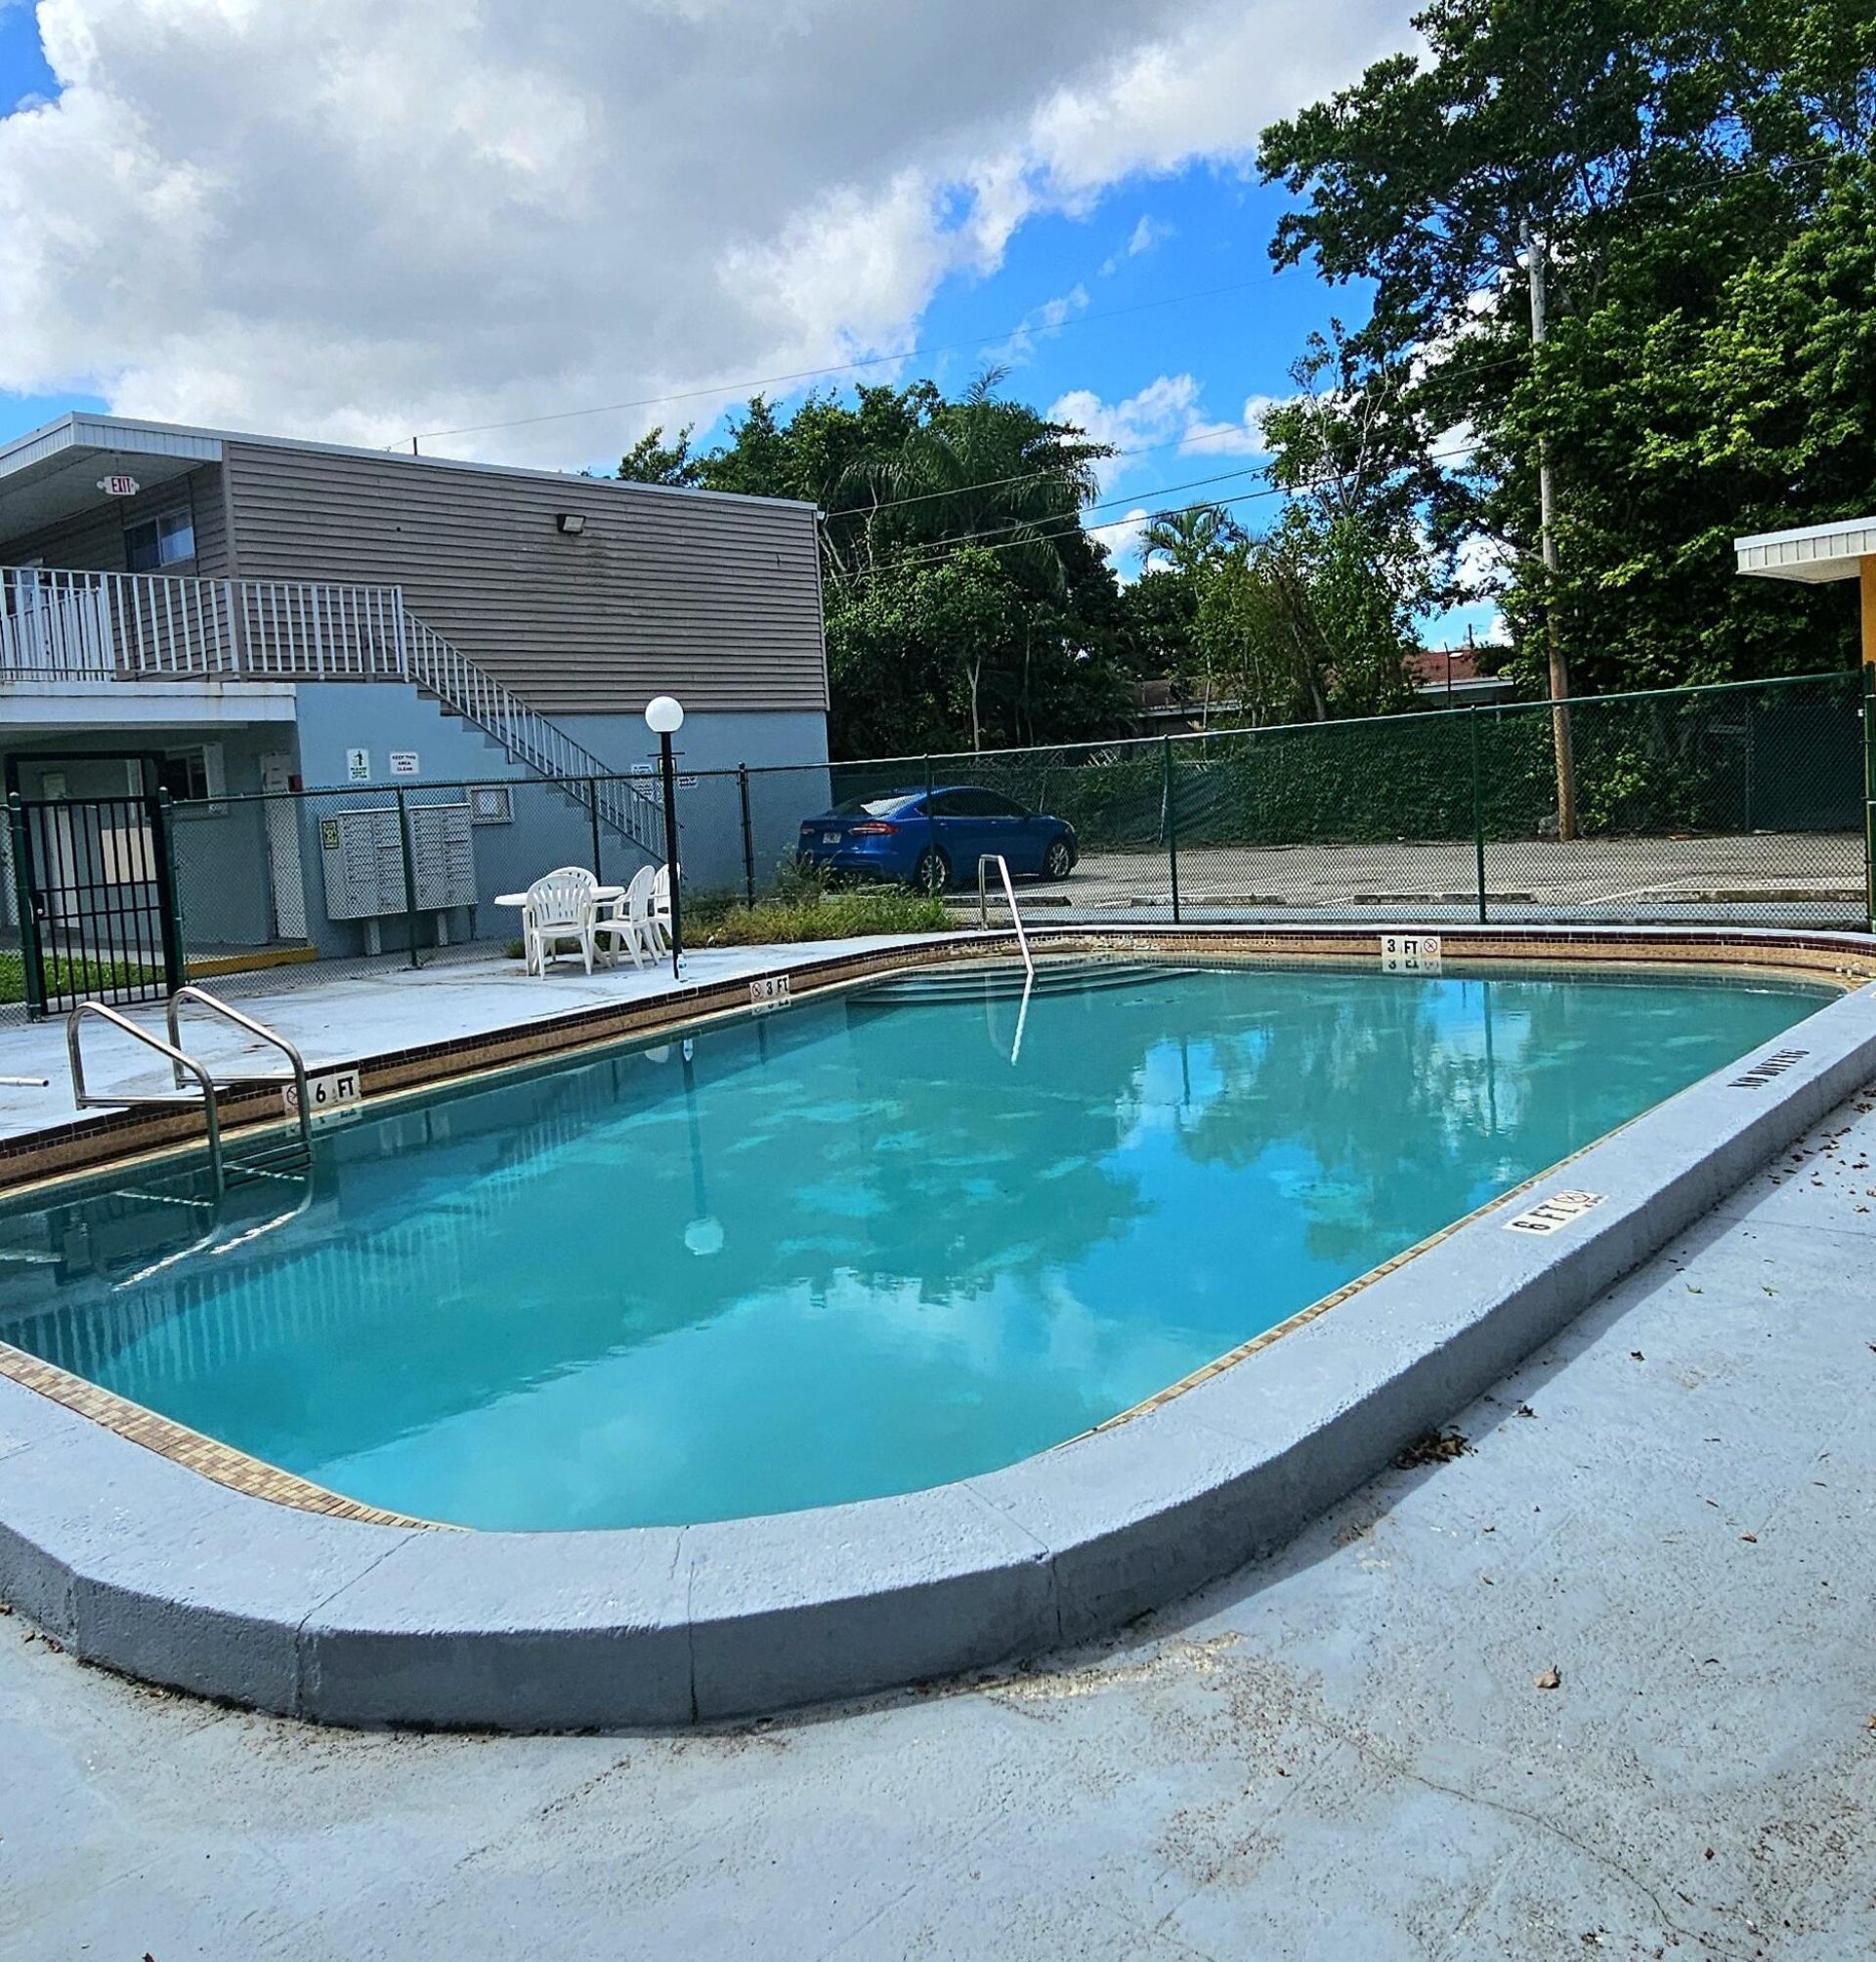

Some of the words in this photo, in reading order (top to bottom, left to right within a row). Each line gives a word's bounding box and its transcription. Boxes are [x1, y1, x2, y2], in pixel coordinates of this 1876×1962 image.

[111, 478, 131, 493] EXIT
[1387, 939, 1396, 953] 3
[1404, 940, 1419, 955] FT
[766, 981, 774, 996] 3
[777, 977, 789, 993] FT
[1746, 1048, 1811, 1077] DIVING
[316, 1083, 326, 1103] 6
[337, 1077, 354, 1098] FT
[1727, 1077, 1769, 1090] NO
[1527, 1204, 1580, 1221] FT
[1512, 1220, 1551, 1231] 6
